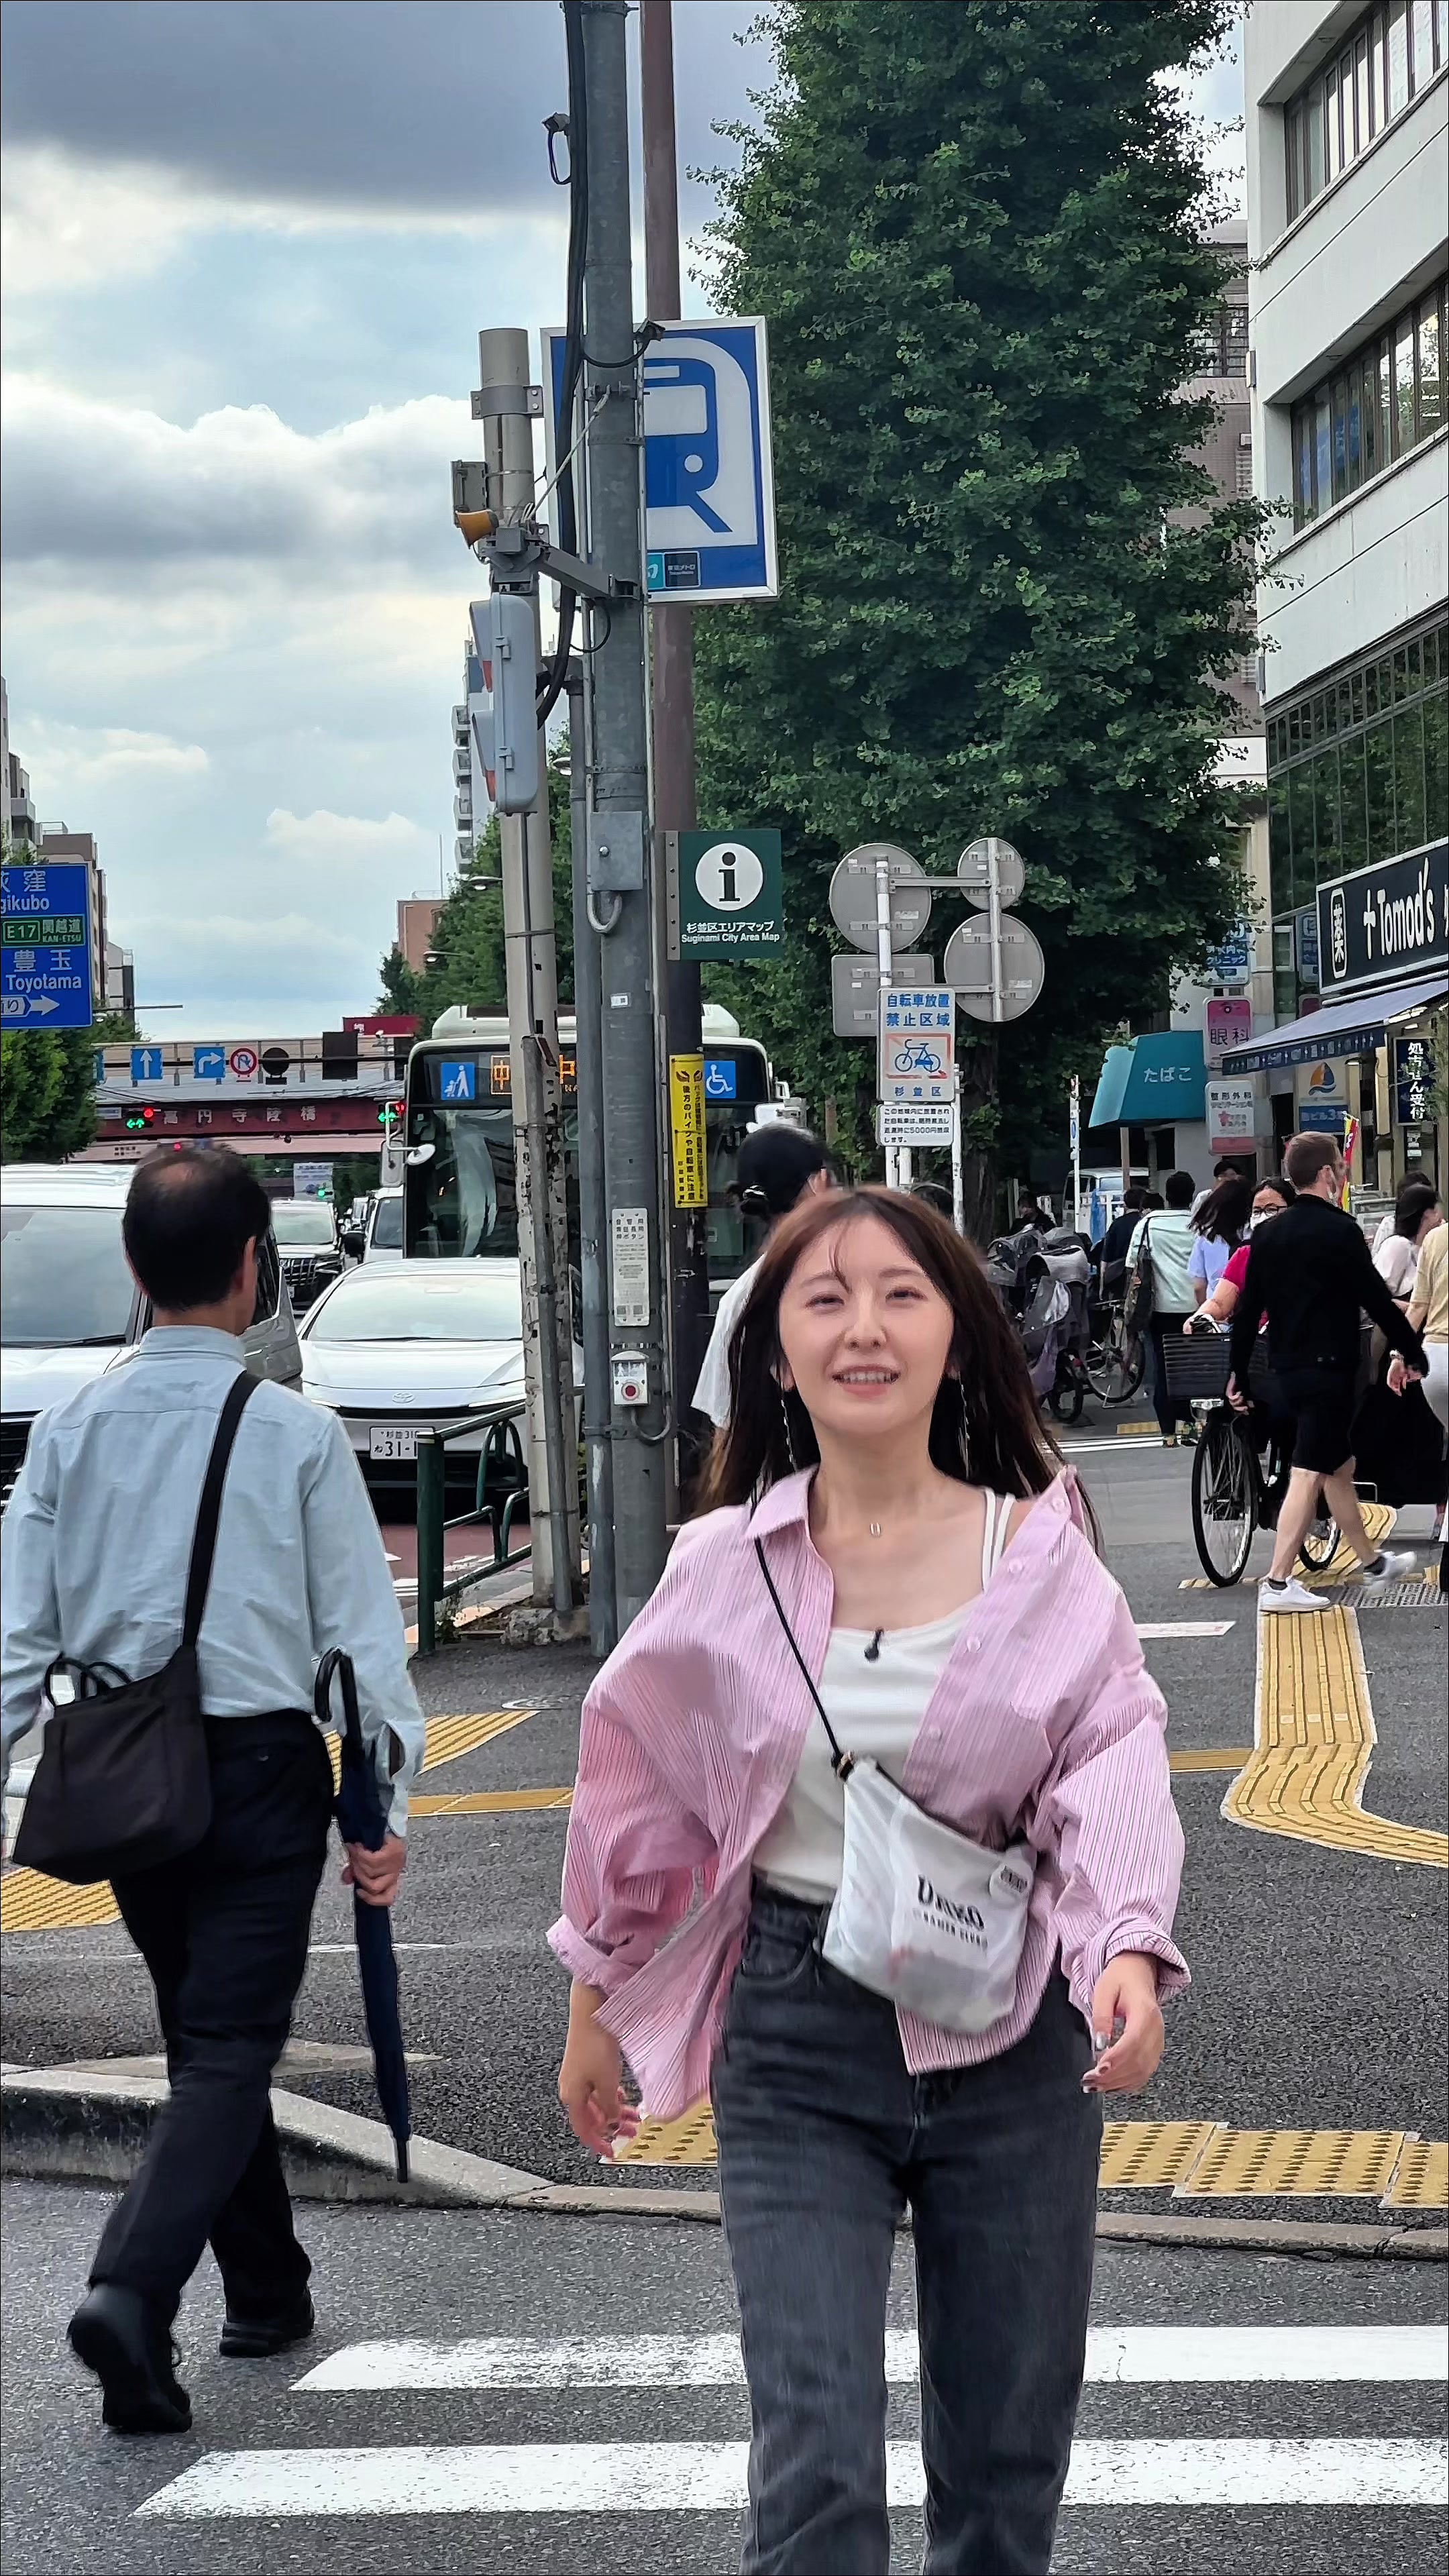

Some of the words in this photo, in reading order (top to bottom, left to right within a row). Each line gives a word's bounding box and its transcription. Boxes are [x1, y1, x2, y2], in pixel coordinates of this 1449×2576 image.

[1377, 857, 1435, 955] Tomod's
[7, 924, 36, 939] E17
[42, 919, 81, 933] 関越道
[686, 920, 775, 933] 杉並区エリアマップ
[681, 934, 720, 944] Suginami
[722, 933, 739, 943] City
[740, 933, 760, 941] Area
[761, 932, 780, 942] Map
[13, 949, 72, 972] 豊玉
[5, 973, 82, 993] Toyotama
[887, 994, 949, 1007] 自転車放置
[886, 1012, 950, 1026] 禁止区域
[1210, 1028, 1250, 1045] 眼科
[1143, 1067, 1192, 1083] たばこ
[894, 1086, 941, 1096] 杉並区
[164, 1106, 317, 1125] 高円寺陸橋
